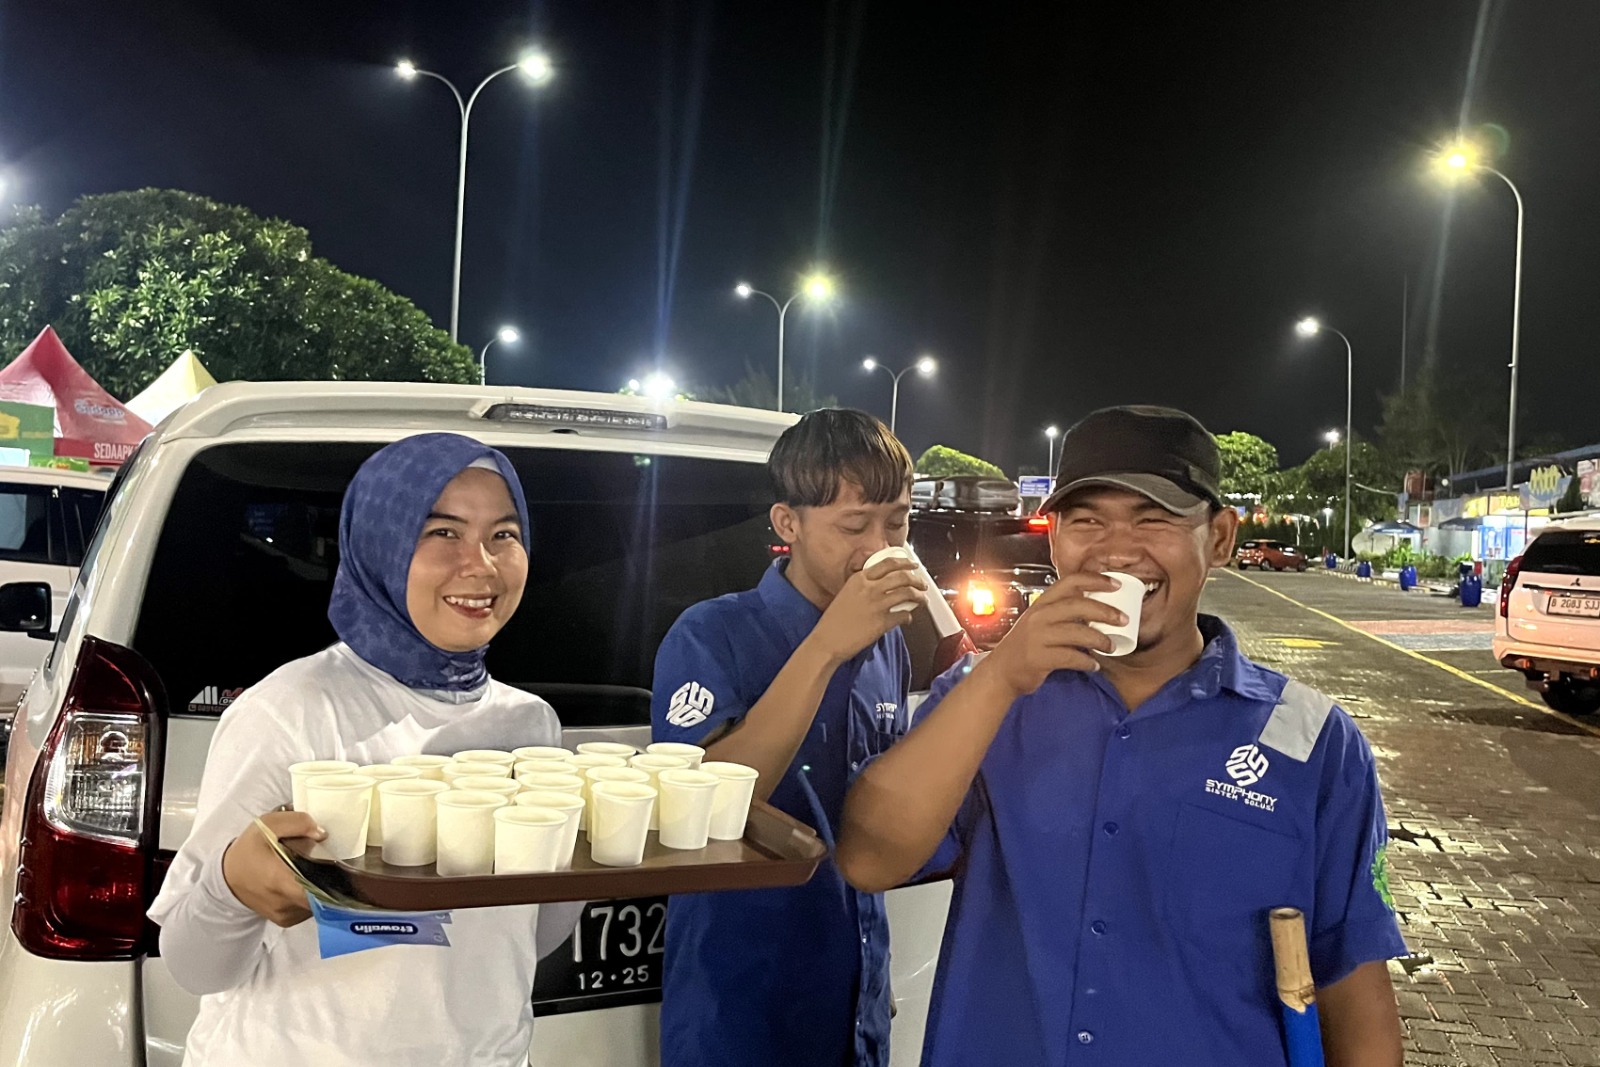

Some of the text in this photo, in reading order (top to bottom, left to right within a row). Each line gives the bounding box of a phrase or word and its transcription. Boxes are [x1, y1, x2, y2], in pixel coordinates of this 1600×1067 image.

[1205, 786, 1275, 813] SISTEM SOLUSI
[1206, 778, 1278, 807] SYMPHONY
[354, 923, 414, 934] Etawalin
[574, 903, 667, 963] 1732
